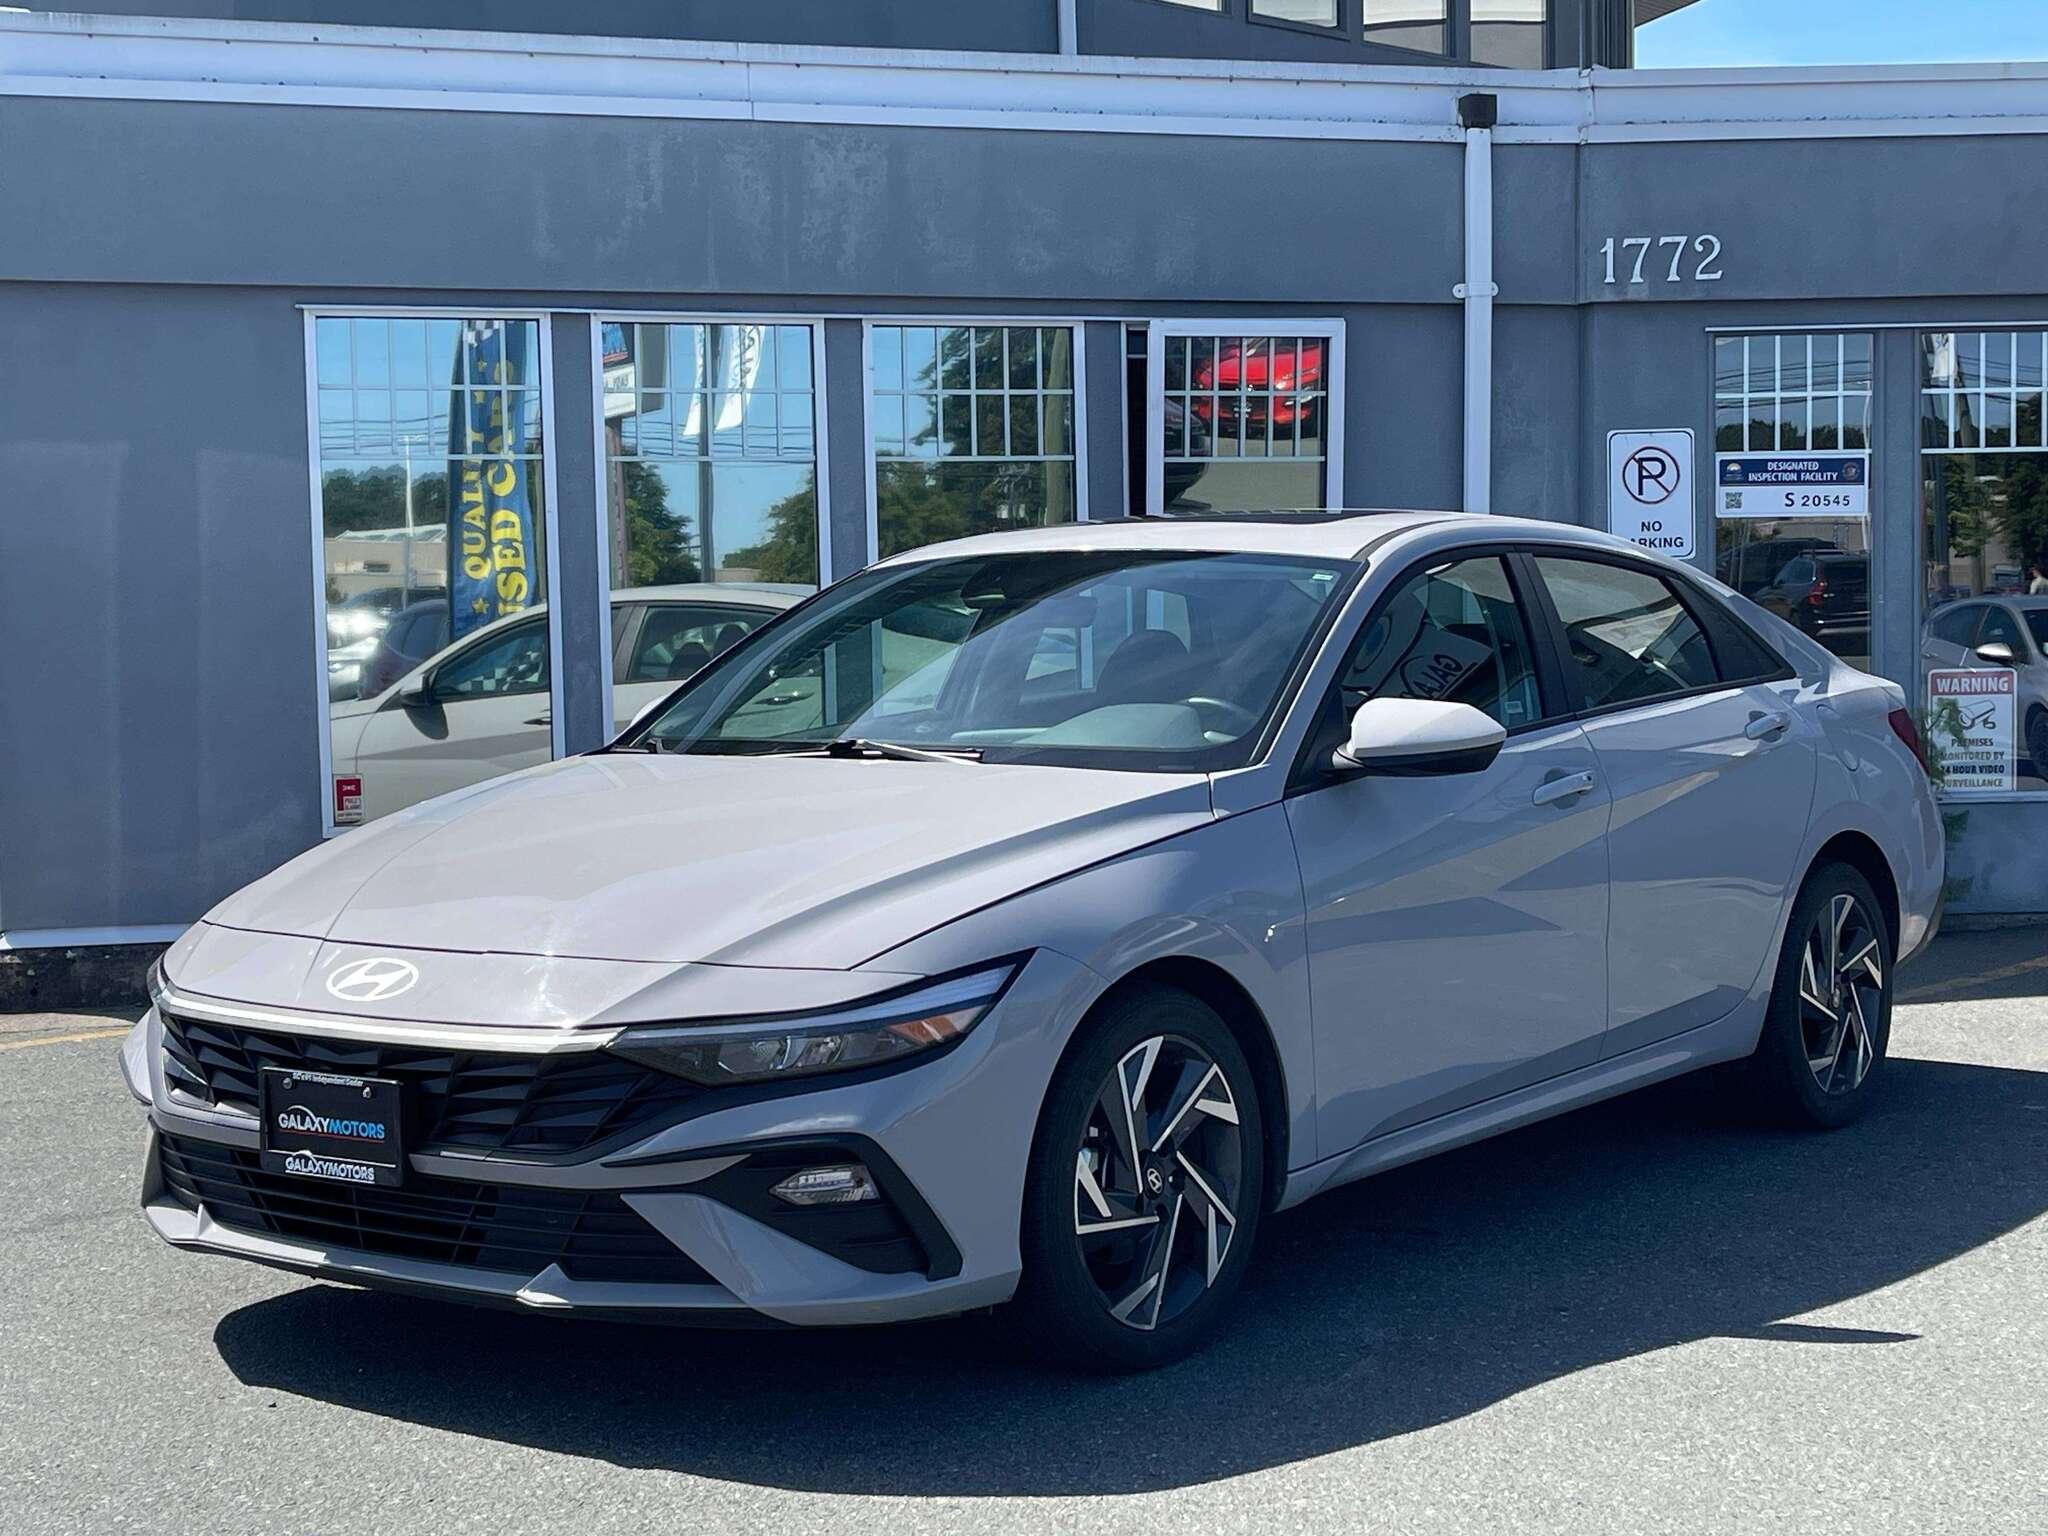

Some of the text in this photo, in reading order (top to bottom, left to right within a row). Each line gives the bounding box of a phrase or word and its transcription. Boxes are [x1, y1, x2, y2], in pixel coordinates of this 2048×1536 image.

[1600, 234, 1723, 284] 1772
[1767, 461, 1820, 471] DESIGNATED
[1748, 472, 1797, 482] INSPECTION
[1800, 472, 1838, 481] FACILITY
[1784, 492, 1850, 508] S 20545
[1641, 521, 1662, 532] NO
[1630, 537, 1684, 548] RKING
[1937, 677, 2008, 692] WARNING
[1993, 751, 2004, 760] BY
[1952, 765, 1977, 774] HOUR
[1979, 765, 2005, 774] VIDEO
[1943, 778, 2003, 788] URVEILLANCE
